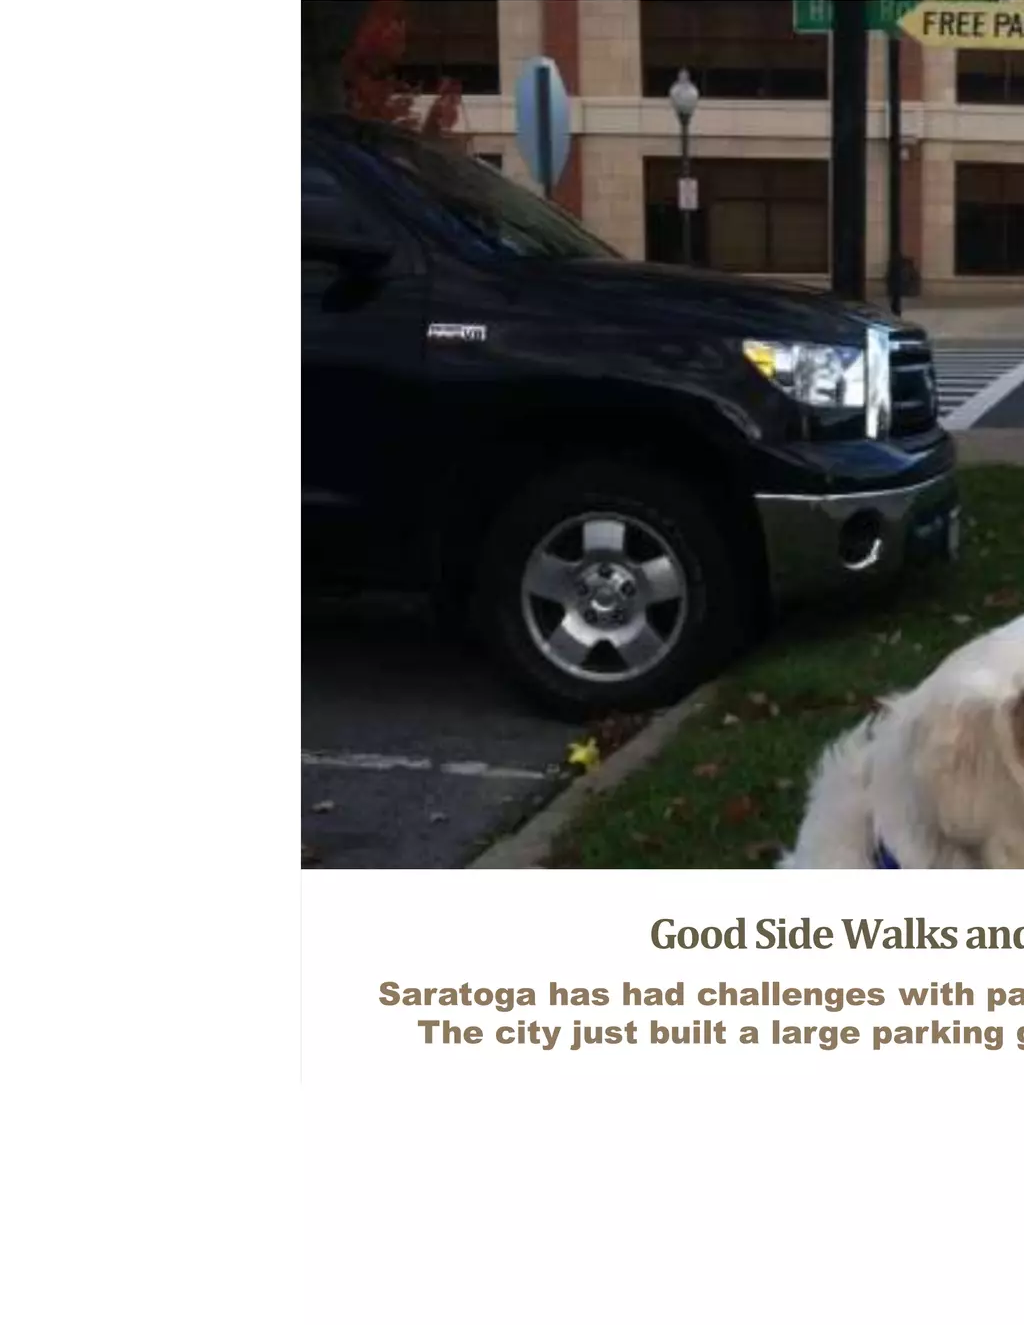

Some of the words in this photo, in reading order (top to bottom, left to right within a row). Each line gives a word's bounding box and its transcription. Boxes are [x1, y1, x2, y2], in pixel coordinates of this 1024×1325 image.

[922, 11, 985, 37] FREE
[651, 918, 747, 950] Good
[756, 918, 833, 950] Side
[841, 918, 957, 950] Walks
[379, 982, 535, 1012] Saratoga
[550, 982, 609, 1006] has
[623, 982, 684, 1006] had
[698, 982, 885, 1012] challenges
[899, 982, 973, 1006] with
[418, 1020, 483, 1044] The
[496, 1020, 561, 1050] city
[570, 1020, 637, 1050] just
[651, 1020, 726, 1044] built
[740, 1026, 758, 1044] a
[773, 1020, 860, 1050] large
[873, 1020, 1003, 1050] parking
